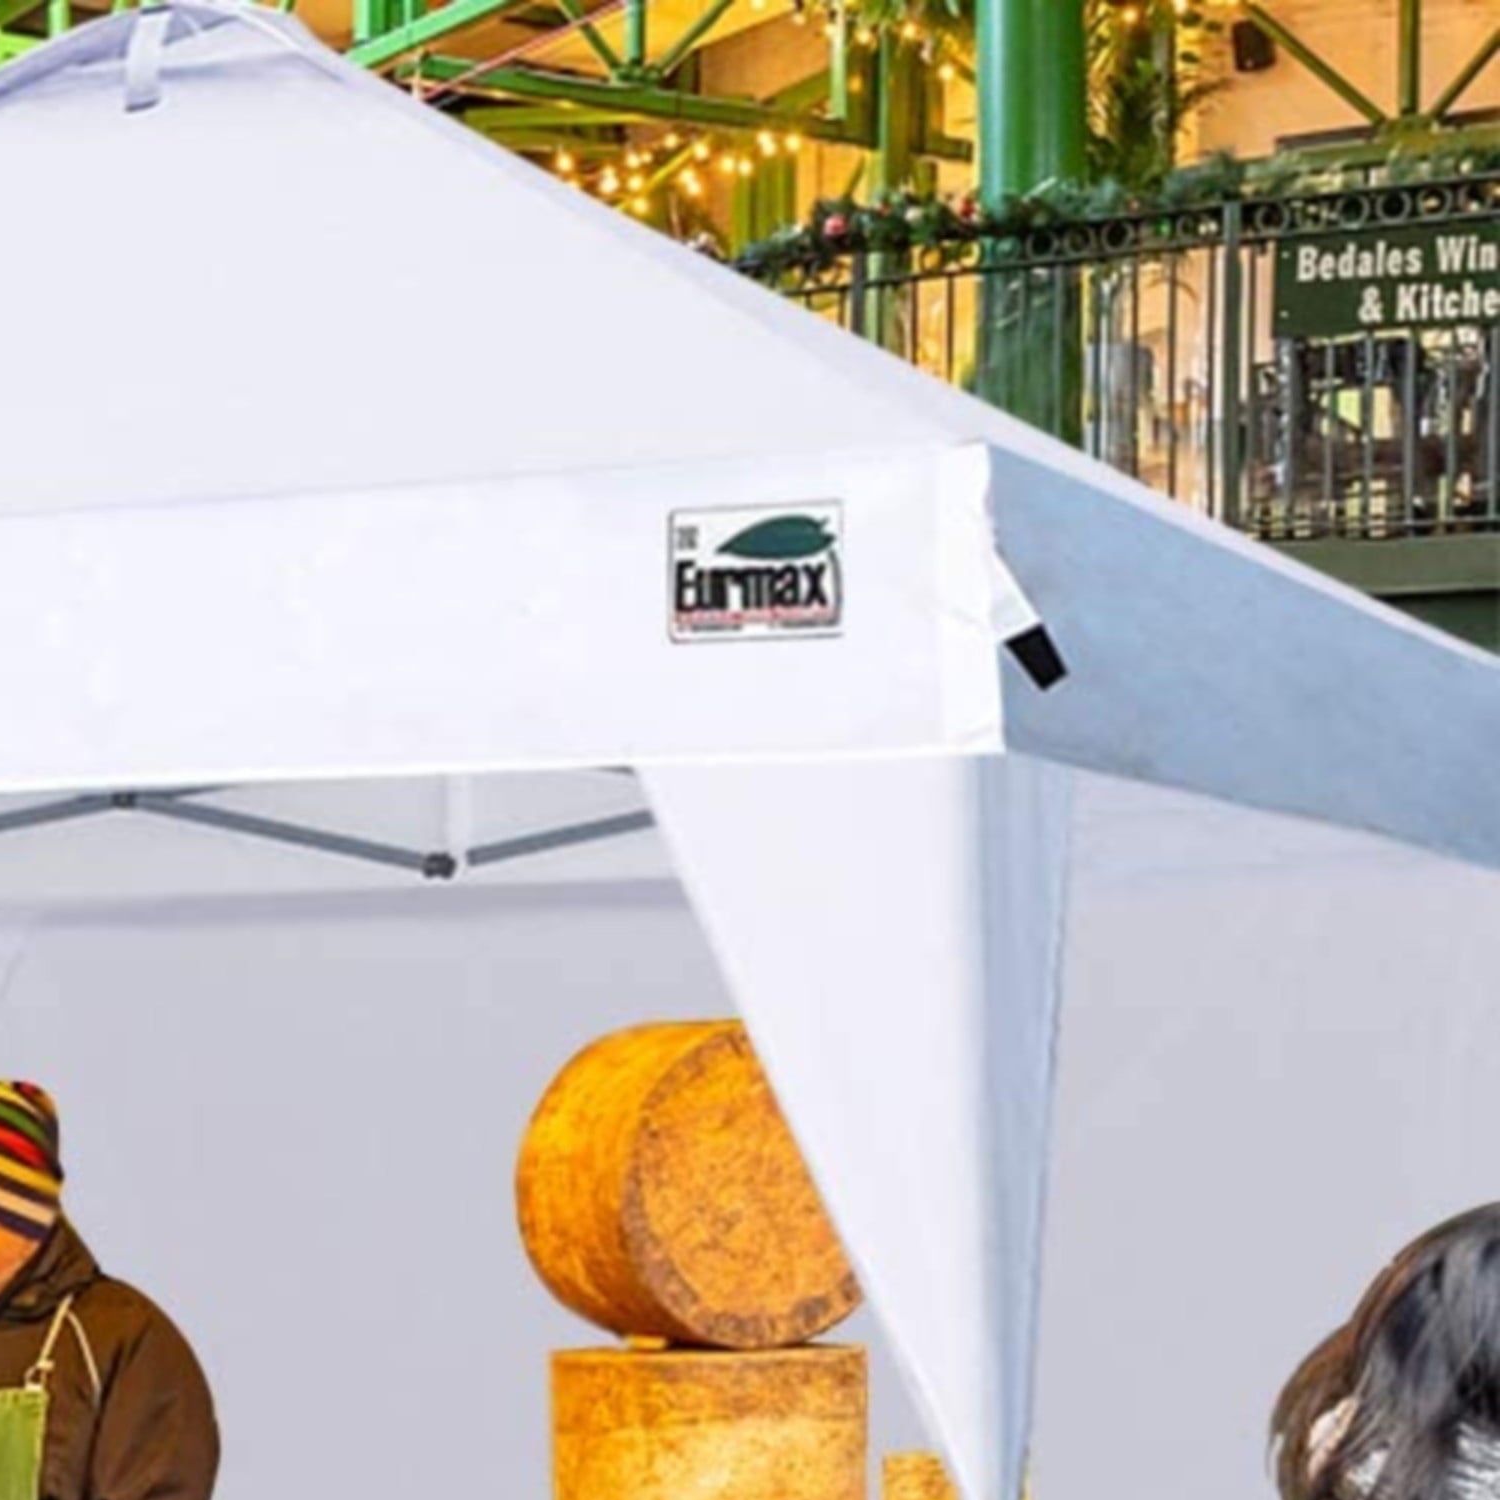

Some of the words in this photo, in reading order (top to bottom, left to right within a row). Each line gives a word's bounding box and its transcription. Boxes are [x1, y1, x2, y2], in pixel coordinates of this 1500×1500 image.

[1297, 240, 1423, 282] Bedales
[1358, 286, 1383, 323] &
[1396, 281, 1500, 322] Kitche
[675, 559, 828, 612] Eurmax
